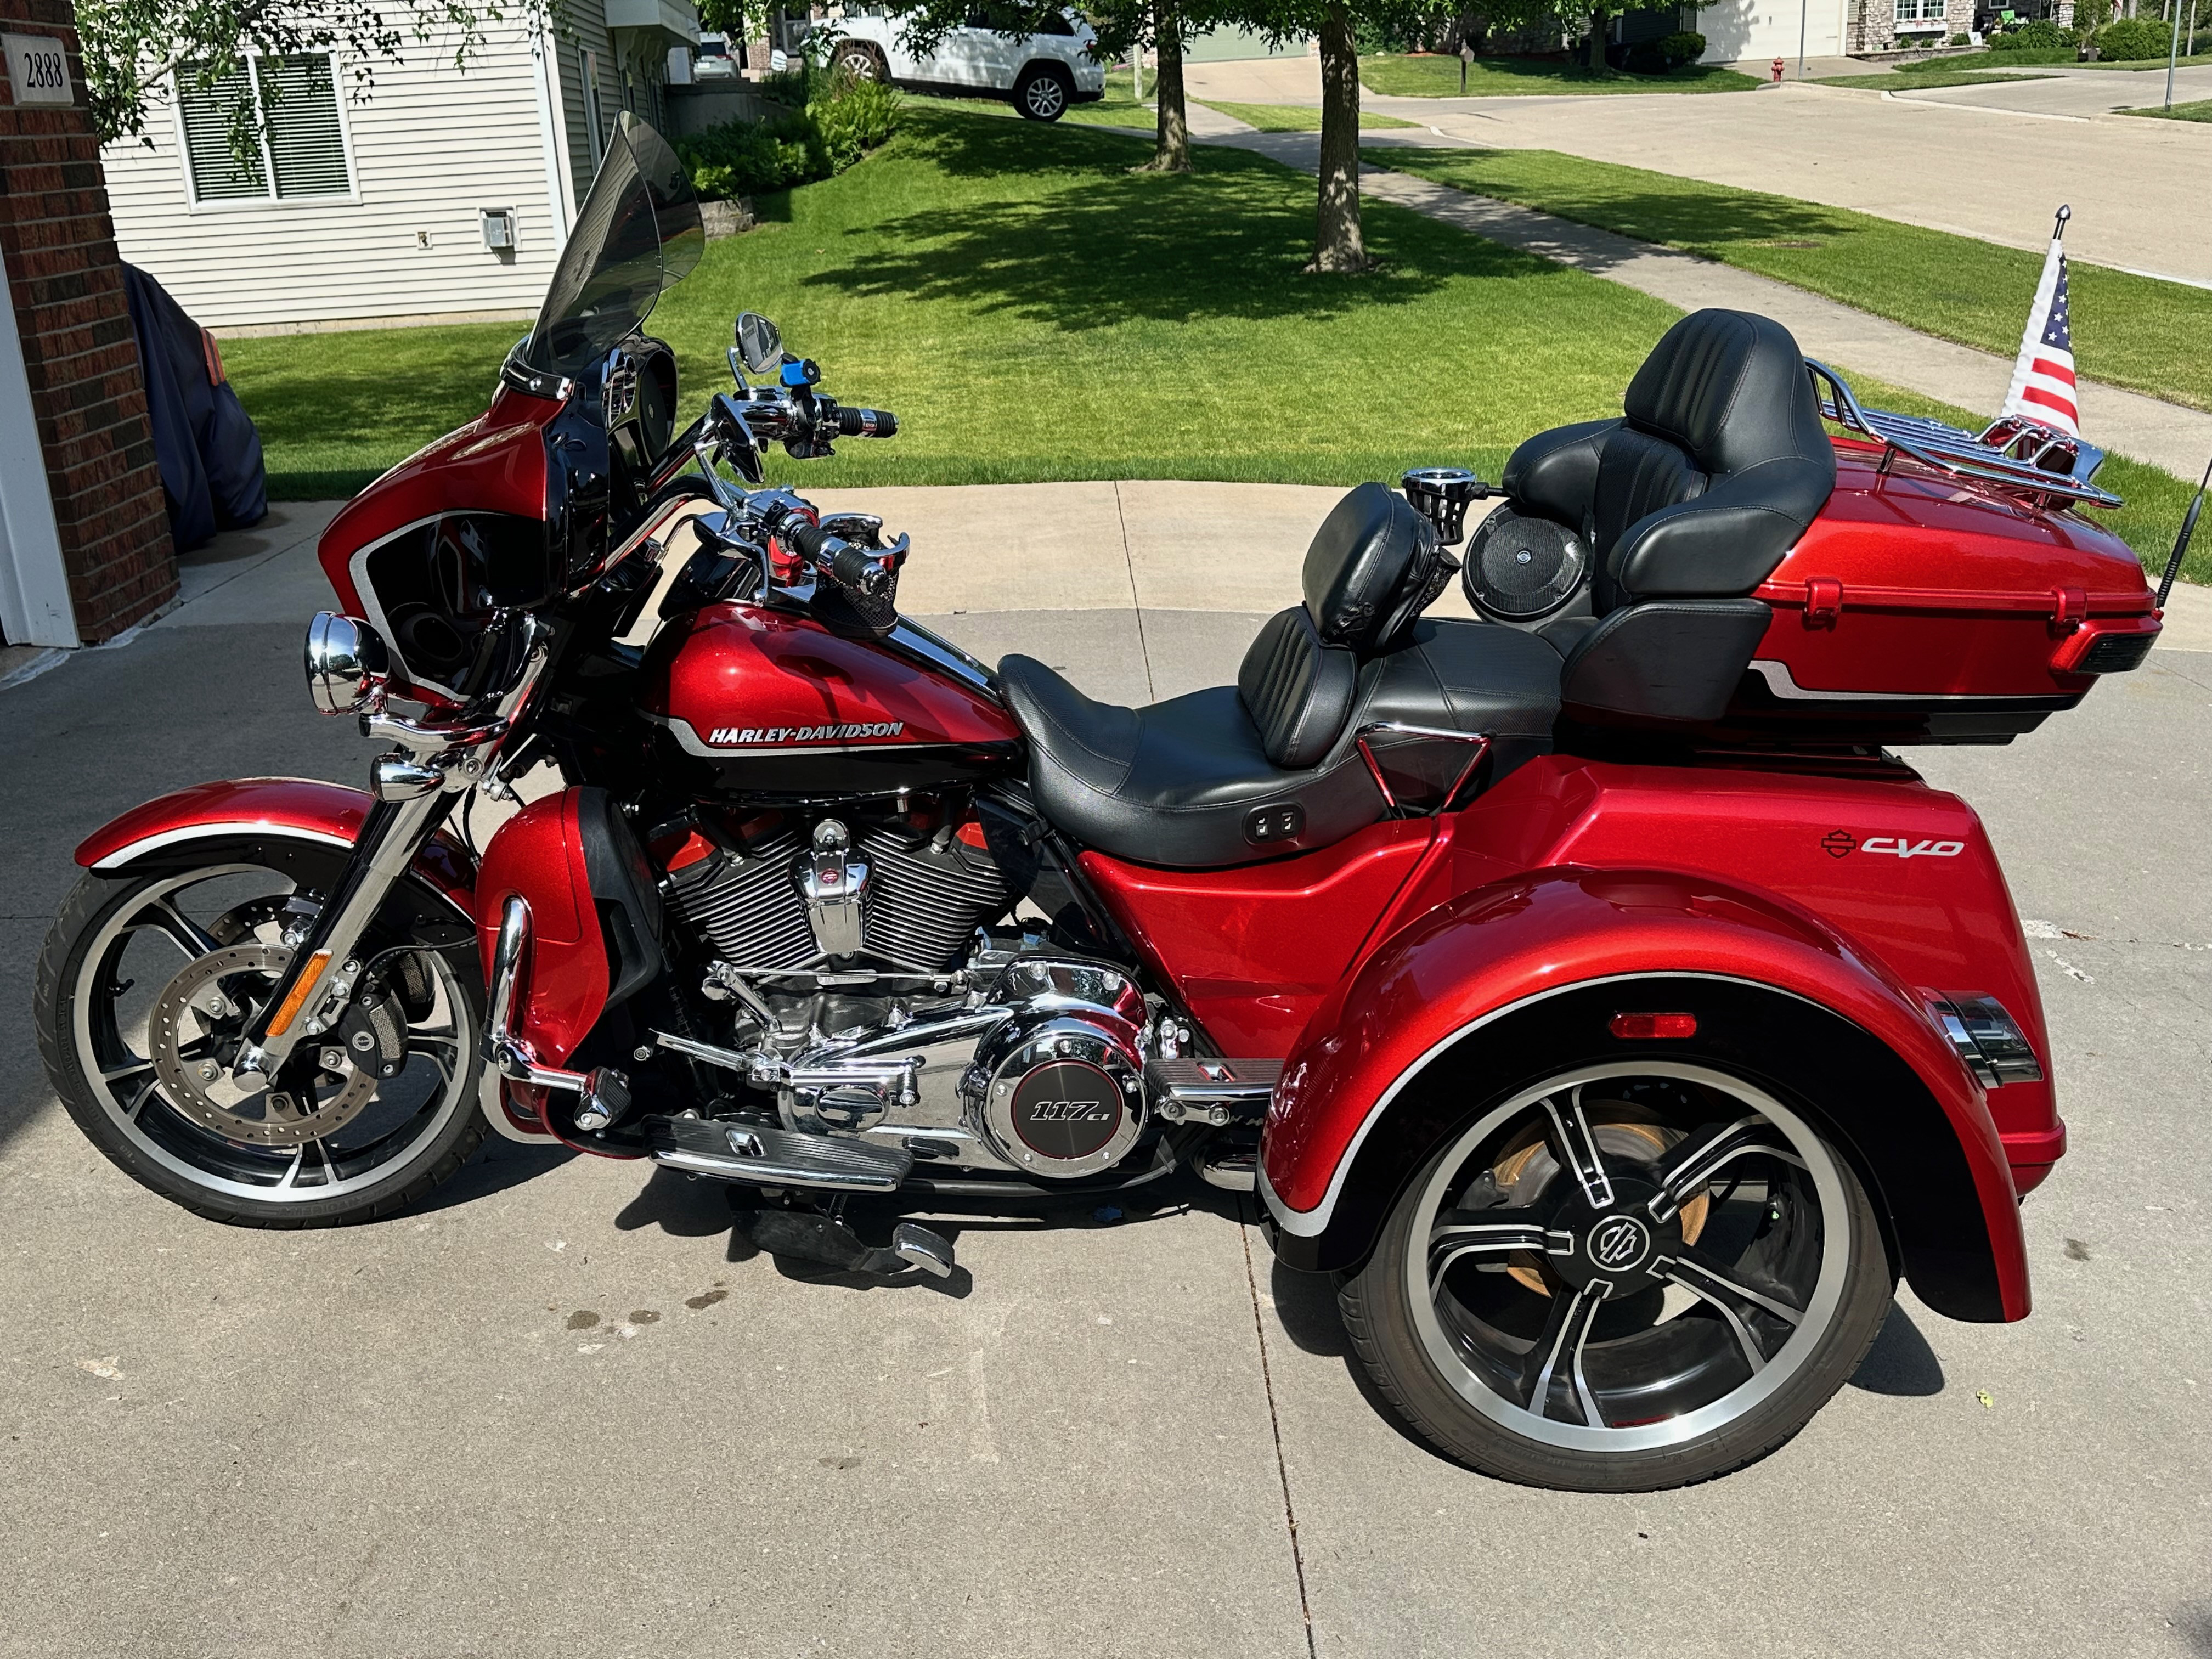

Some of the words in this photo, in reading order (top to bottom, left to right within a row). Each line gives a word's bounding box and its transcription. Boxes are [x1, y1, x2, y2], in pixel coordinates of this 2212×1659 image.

[24, 52, 63, 88] 2888
[709, 722, 904, 743] HARLEY-DAVIDSON
[1861, 837, 1965, 858] CVO
[1030, 1101, 1099, 1120] 117
